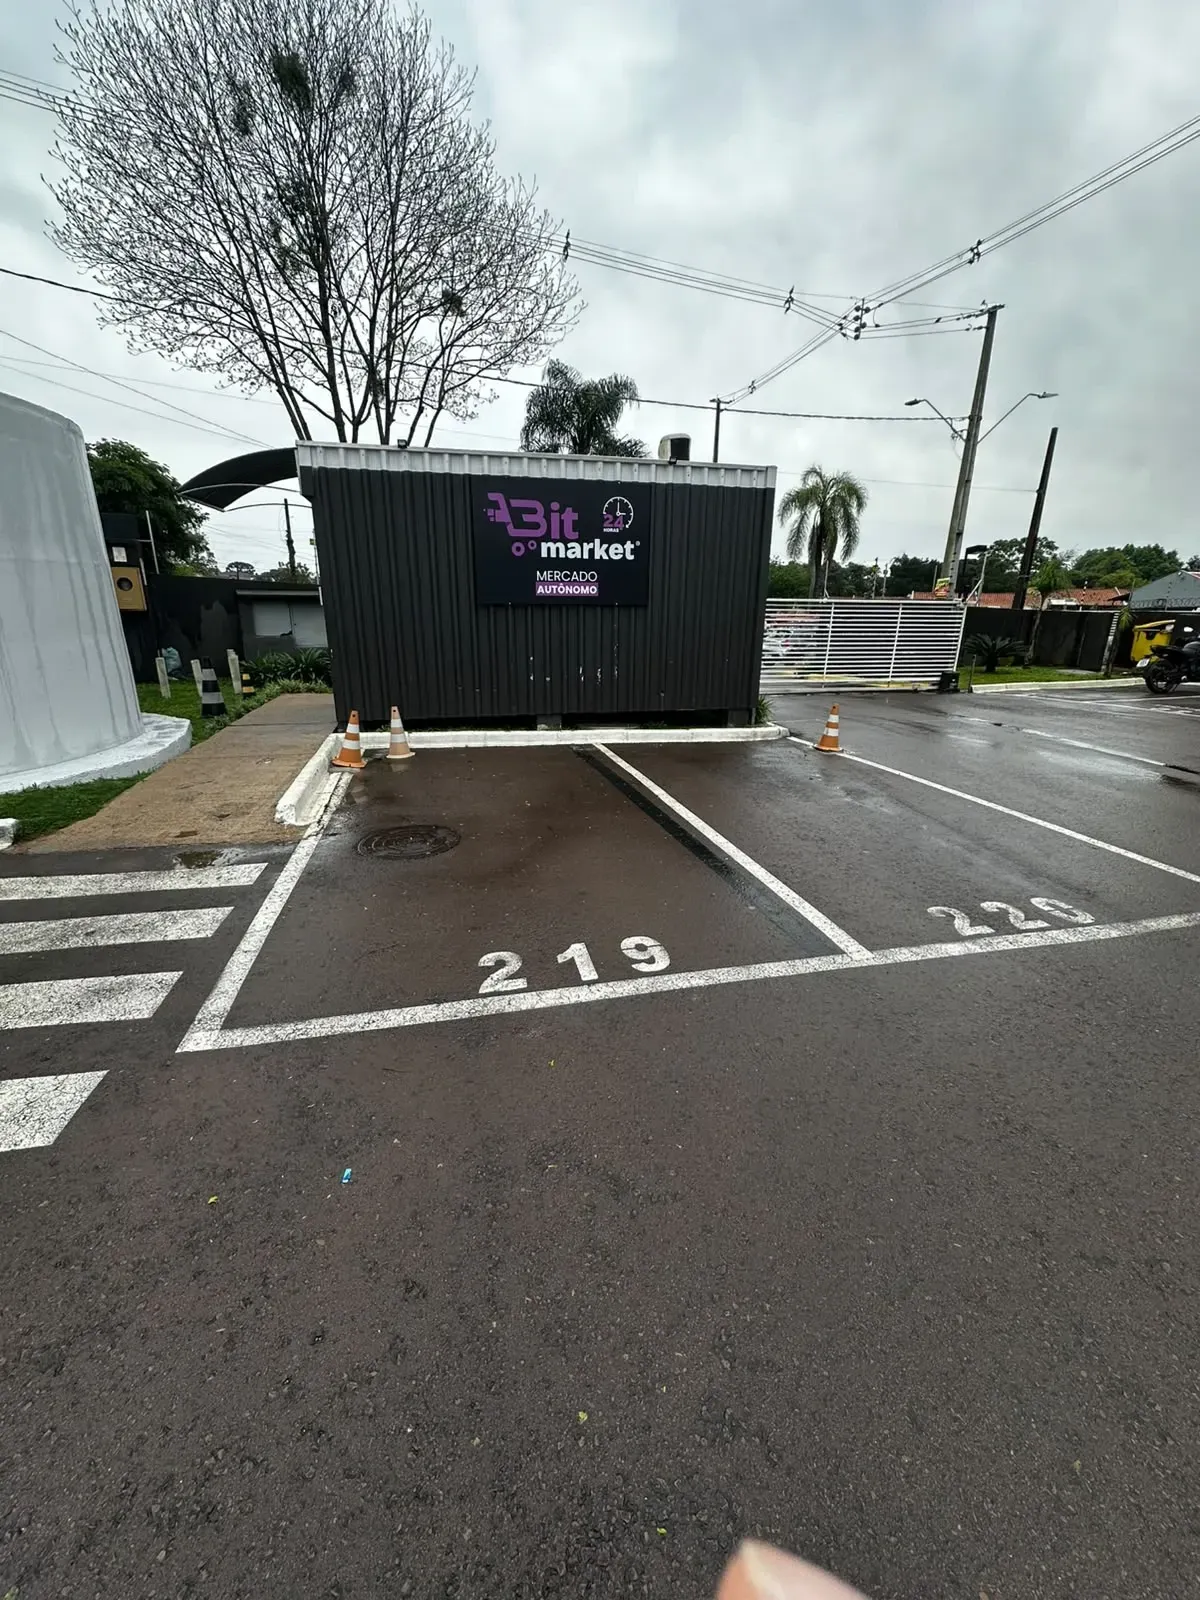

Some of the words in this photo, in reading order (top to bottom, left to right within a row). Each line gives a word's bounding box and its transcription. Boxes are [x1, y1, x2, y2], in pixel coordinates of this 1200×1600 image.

[506, 498, 579, 539] Bit
[603, 513, 625, 529] 24
[536, 570, 598, 583] MERCADO
[536, 583, 598, 595] AUTÔNOMO
[926, 897, 1096, 937] 220
[477, 935, 671, 994] 219
